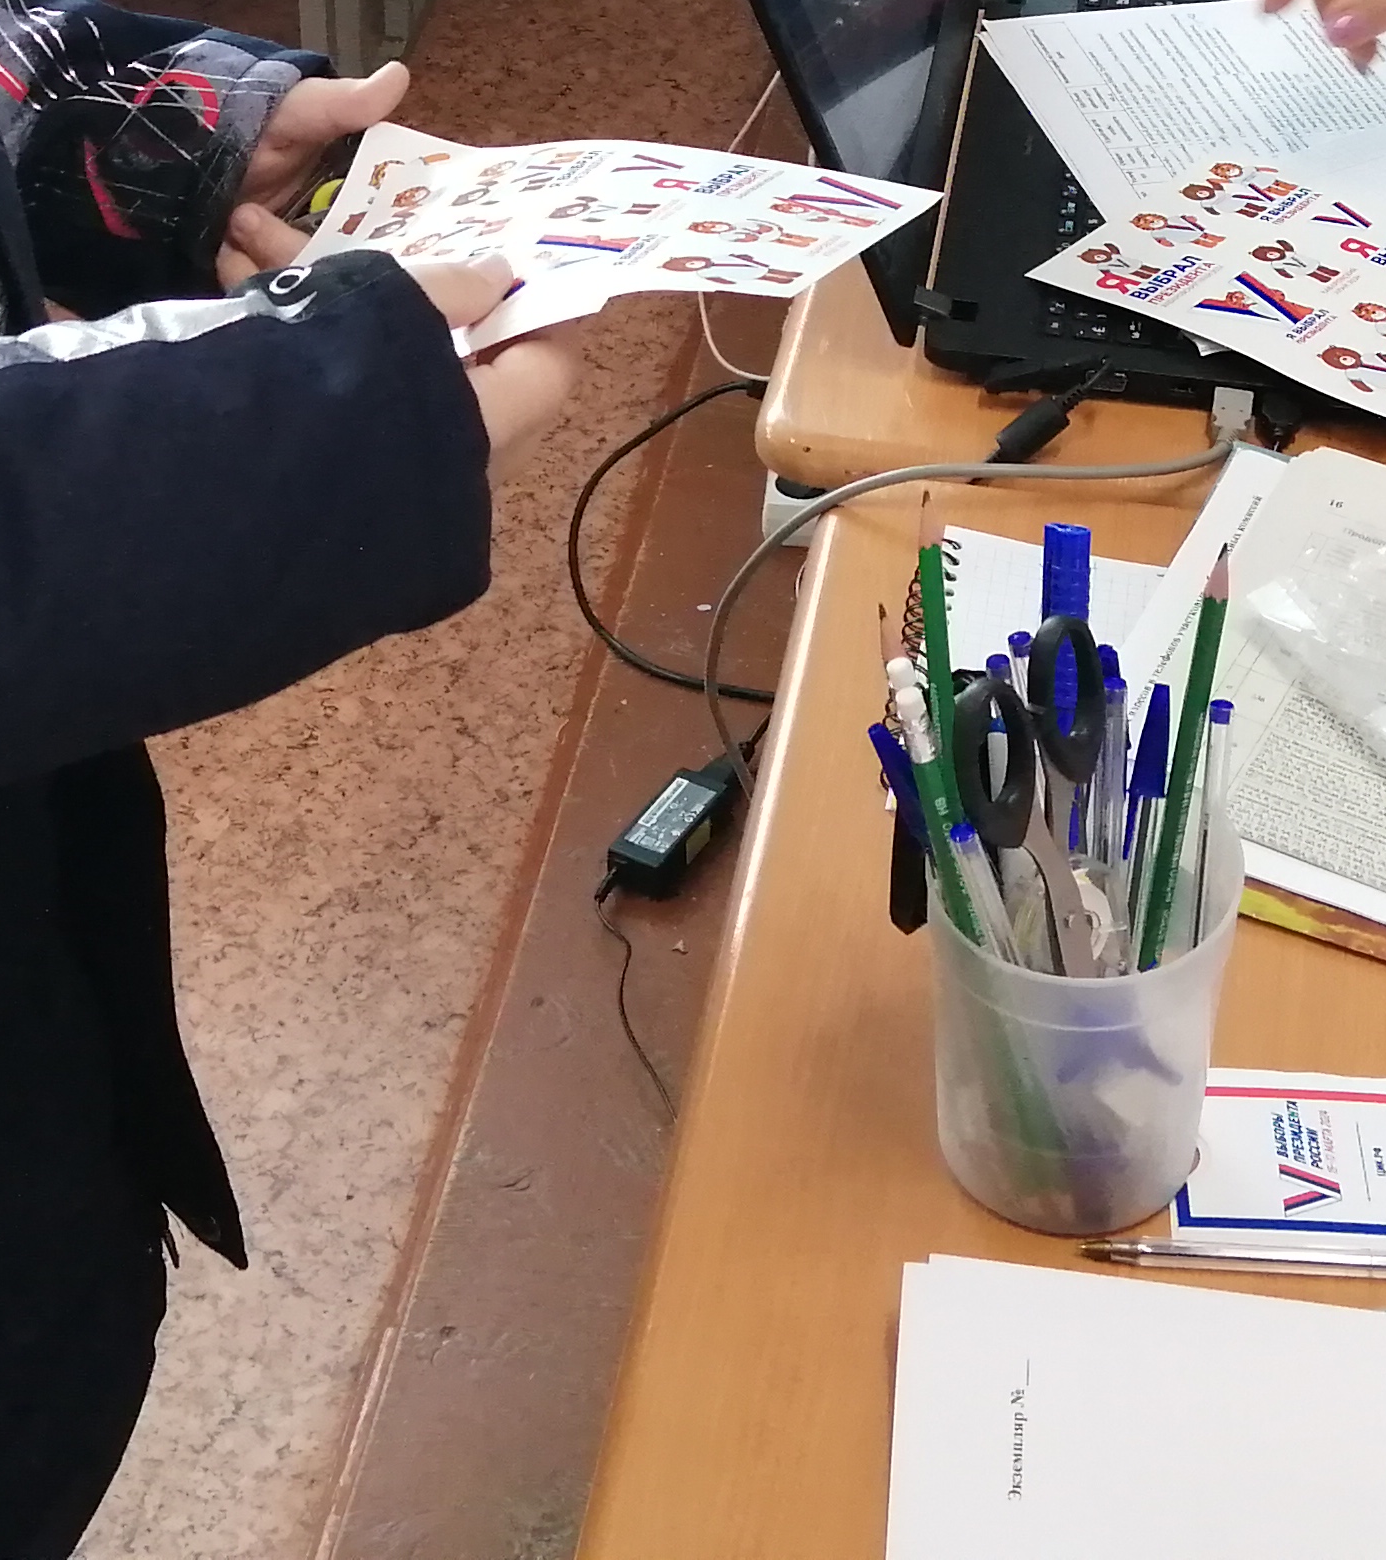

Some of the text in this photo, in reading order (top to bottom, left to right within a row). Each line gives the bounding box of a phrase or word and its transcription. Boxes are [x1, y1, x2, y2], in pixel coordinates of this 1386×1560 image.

[1340, 237, 1380, 259] Я
[1096, 271, 1142, 295] Я
[1129, 255, 1203, 301] ВЫБРАЛ
[1147, 261, 1216, 307] ПРЕЗИДЕНТА
[1271, 1111, 1289, 1159] ВЫБОРЫ
[1286, 1100, 1307, 1165] ПРЕЗИДЕНТА
[1306, 1127, 1323, 1170] РОССИИ
[1007, 1411, 1028, 1502] Экземпляр
